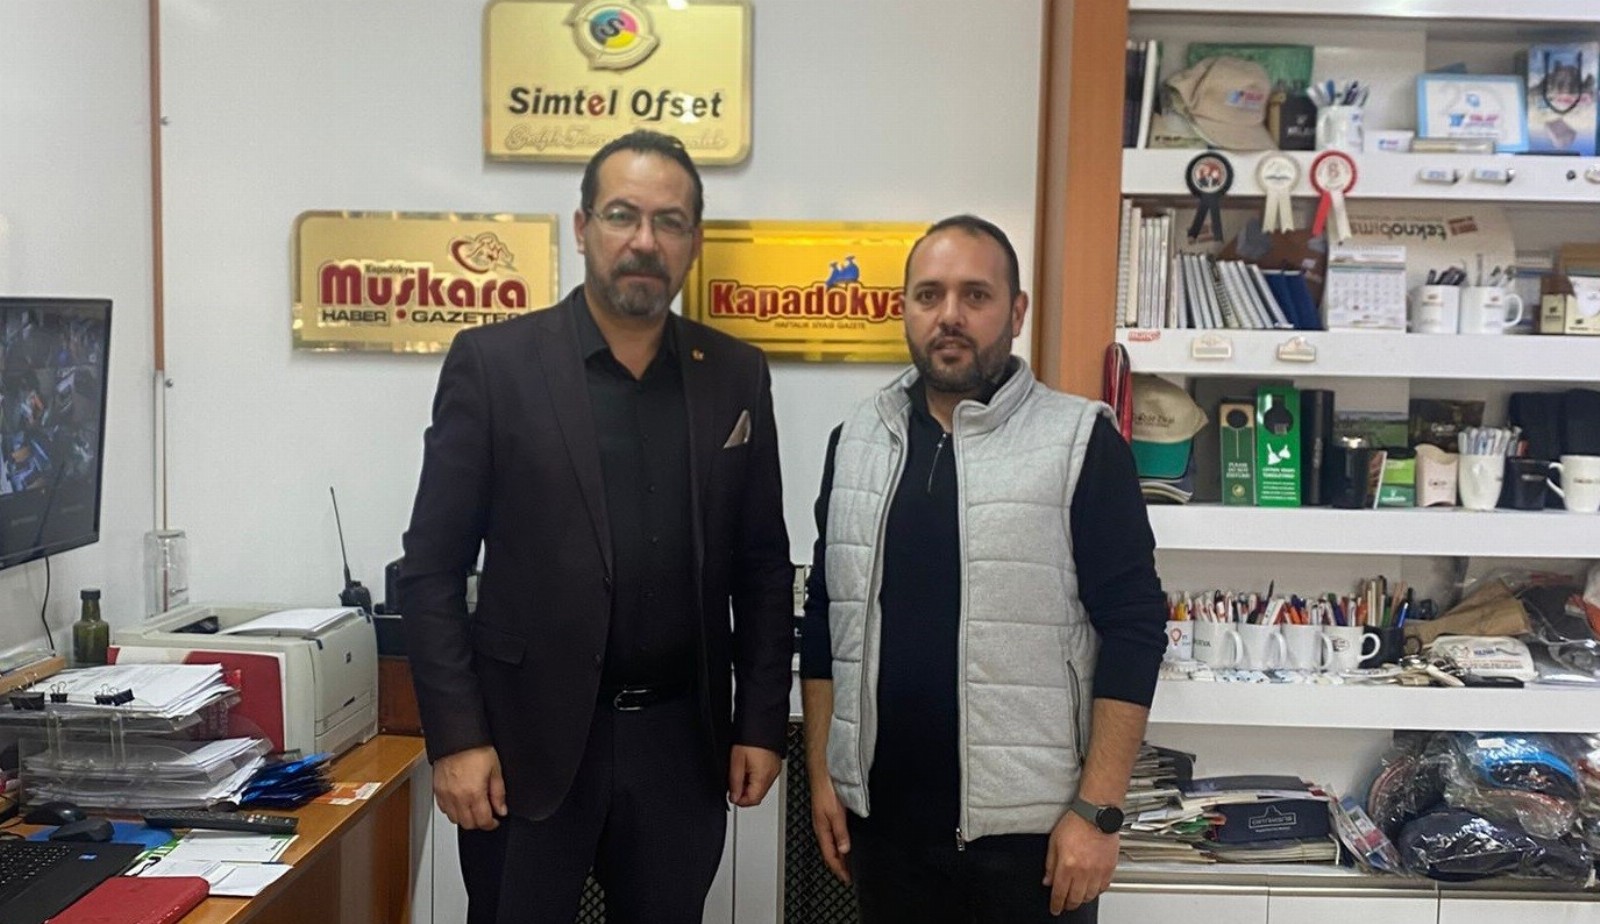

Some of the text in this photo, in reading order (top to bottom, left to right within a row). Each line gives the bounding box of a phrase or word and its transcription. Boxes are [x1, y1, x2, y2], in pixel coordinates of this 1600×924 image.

[508, 87, 724, 122] Simtel Ofset
[321, 310, 388, 323] HABER
[711, 282, 904, 319] Kapadokya
